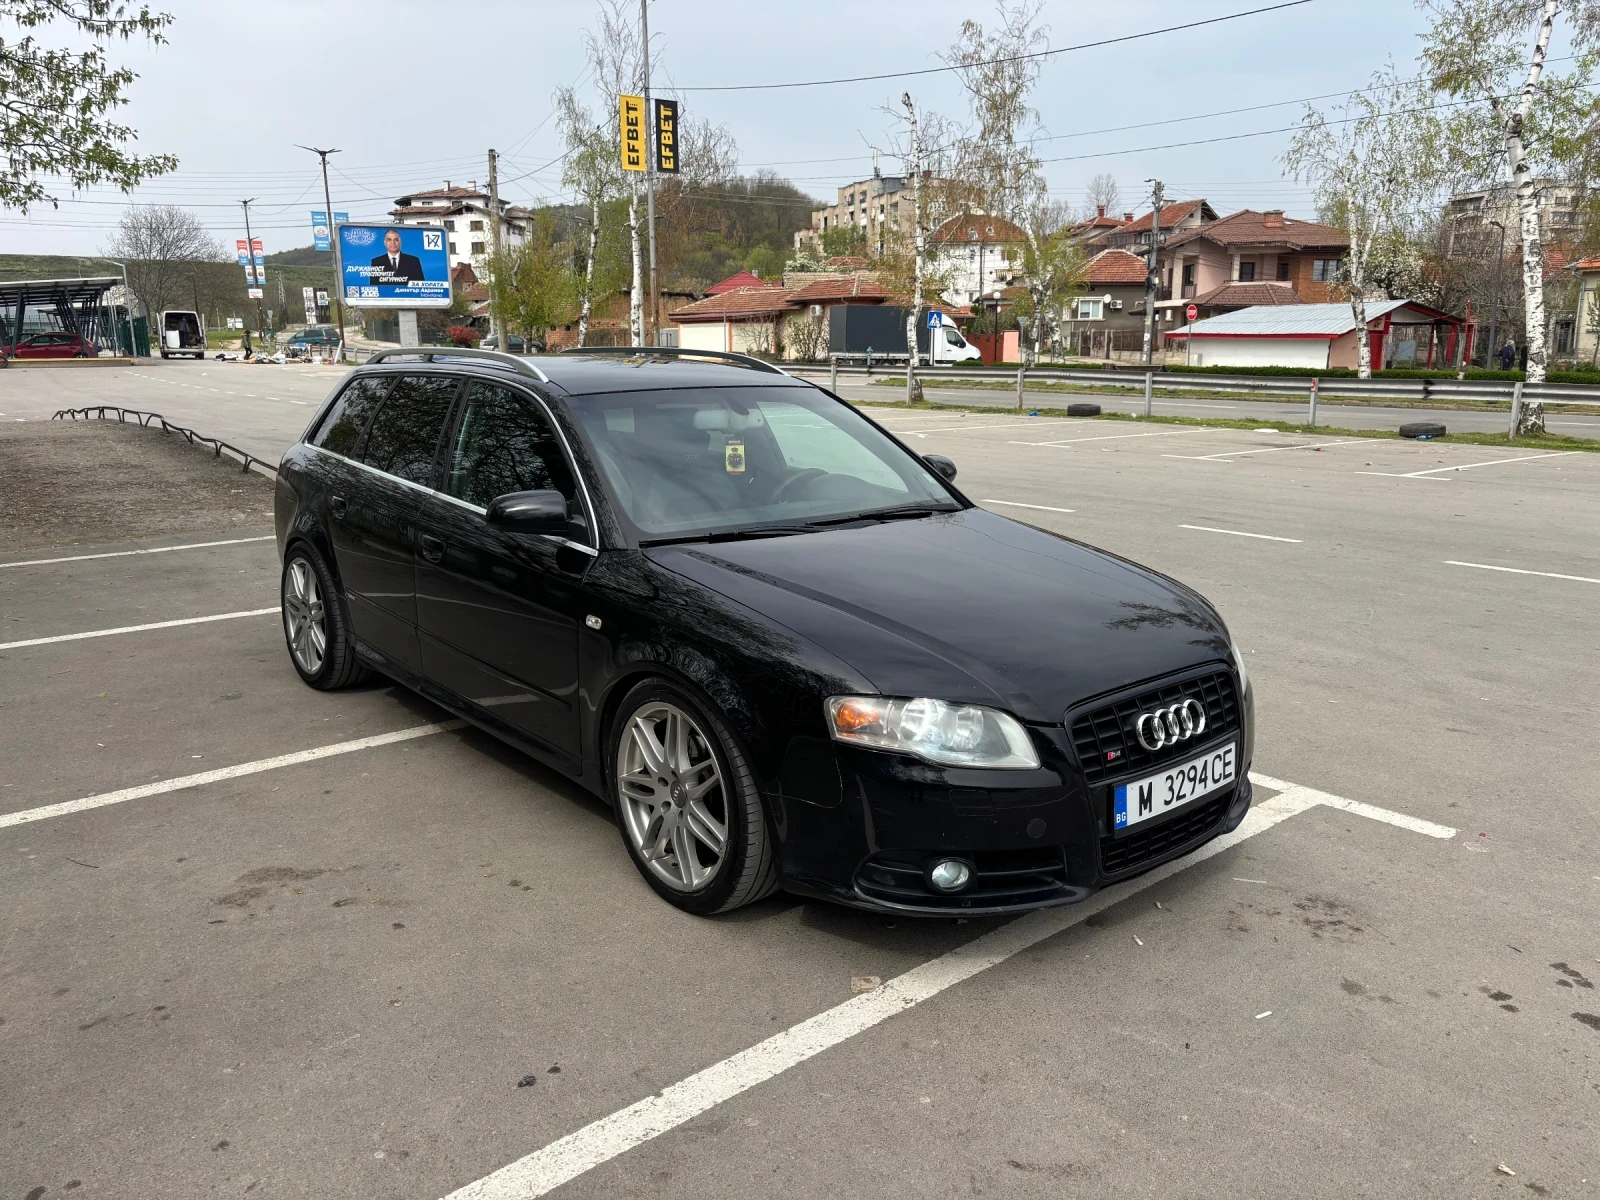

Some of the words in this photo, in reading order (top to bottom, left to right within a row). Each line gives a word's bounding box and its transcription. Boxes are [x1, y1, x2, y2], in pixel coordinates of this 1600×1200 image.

[626, 100, 639, 165] EFBET
[660, 104, 674, 169] EFBET
[1116, 812, 1127, 823] BG
[1138, 781, 1153, 817] M
